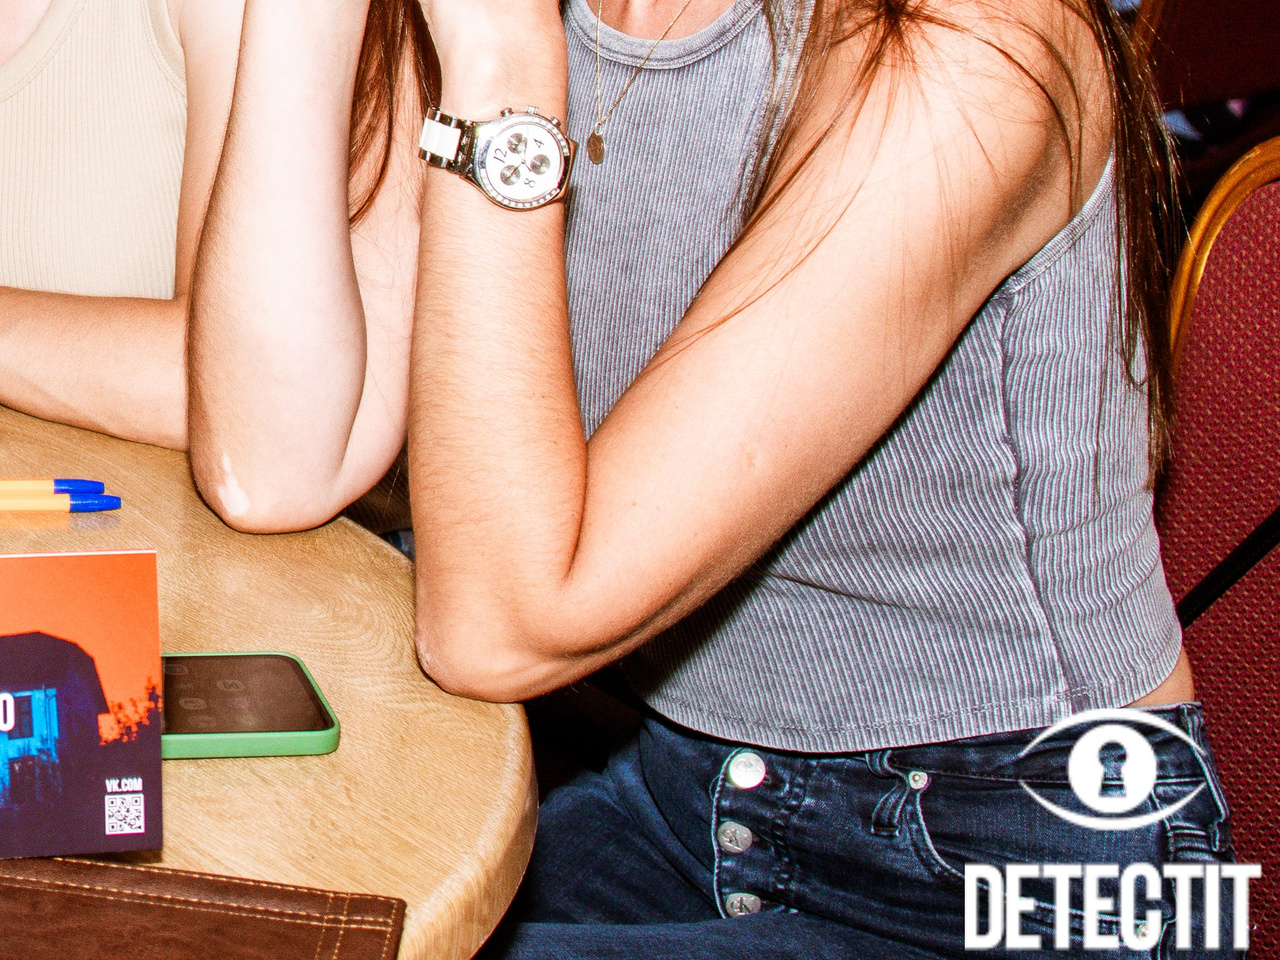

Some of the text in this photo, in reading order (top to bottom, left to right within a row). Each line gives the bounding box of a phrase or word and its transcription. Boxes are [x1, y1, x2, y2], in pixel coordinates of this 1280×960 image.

[533, 138, 545, 149] 4
[493, 148, 508, 164] 12
[523, 178, 536, 189] 8
[105, 778, 143, 792] VK.COM
